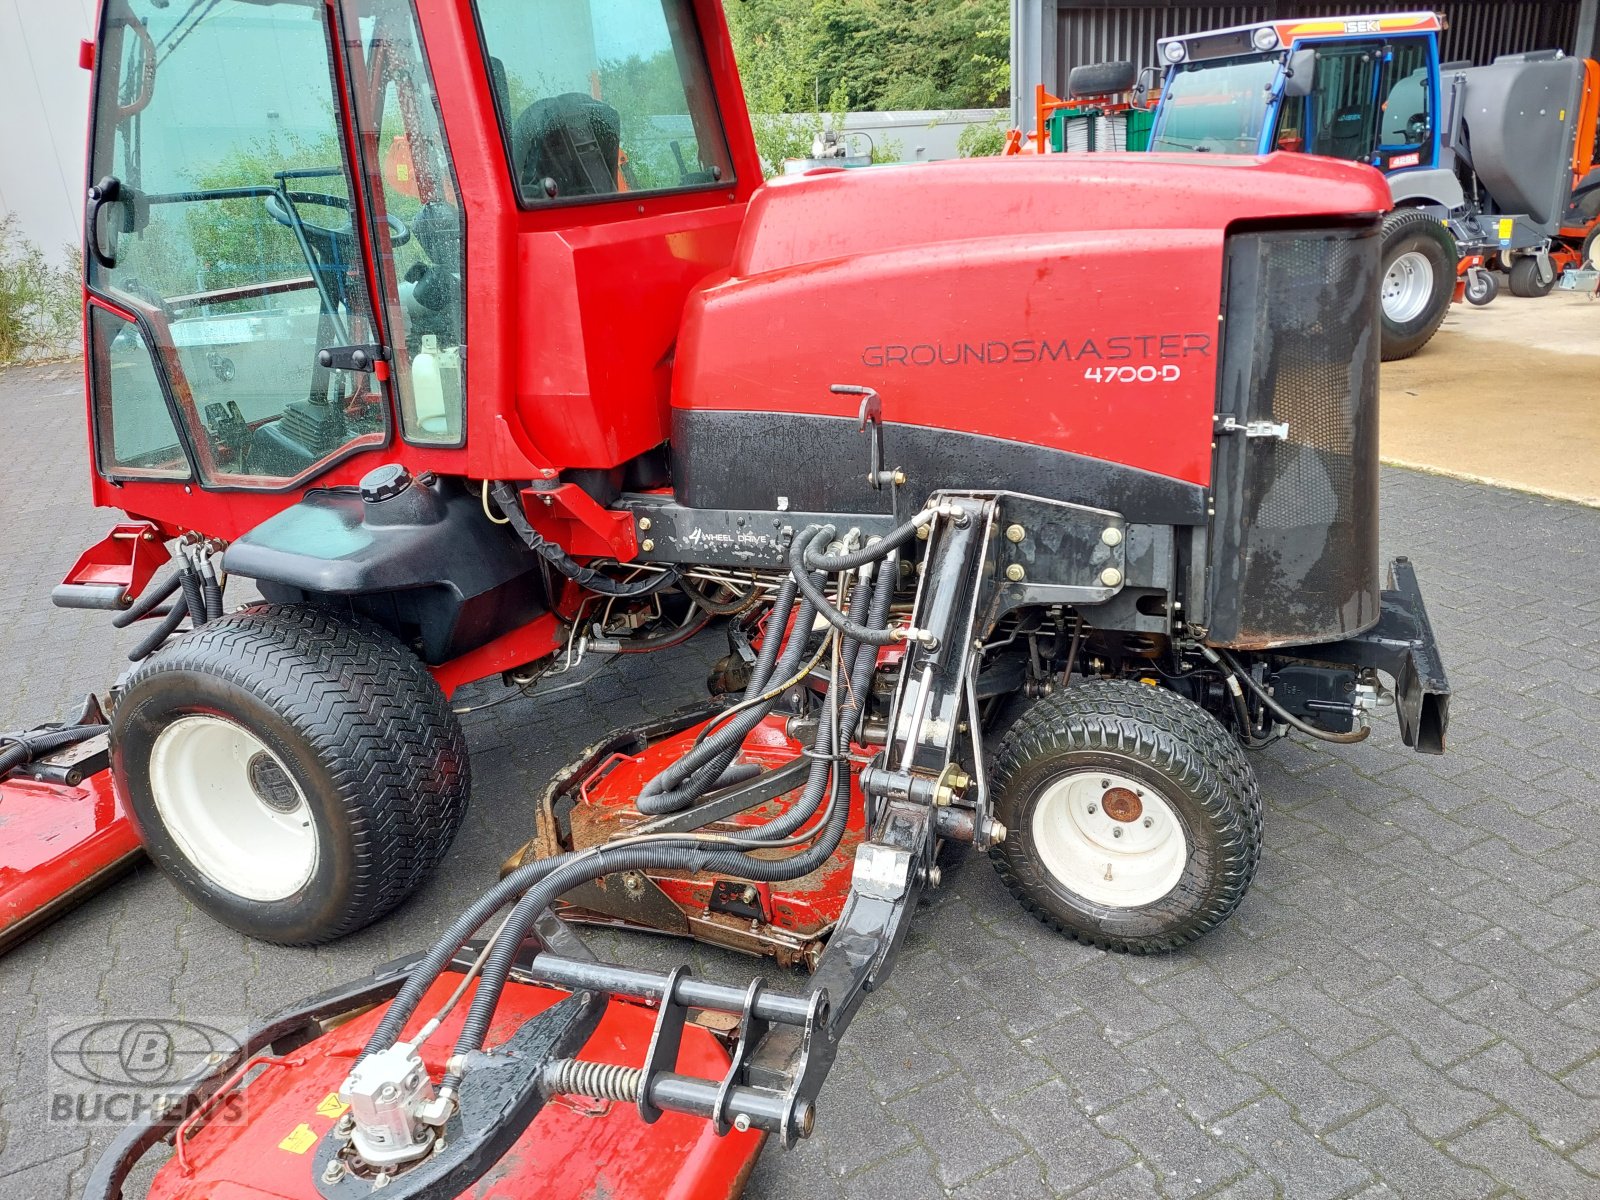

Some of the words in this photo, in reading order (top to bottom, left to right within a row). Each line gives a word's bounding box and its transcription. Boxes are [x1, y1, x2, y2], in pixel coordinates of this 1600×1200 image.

[1343, 20, 1381, 33] ISEKI
[861, 332, 1211, 367] GROUNDSMASTER
[688, 527, 702, 545] 4
[701, 533, 735, 542] WHEEL
[737, 533, 768, 543] DRIVE
